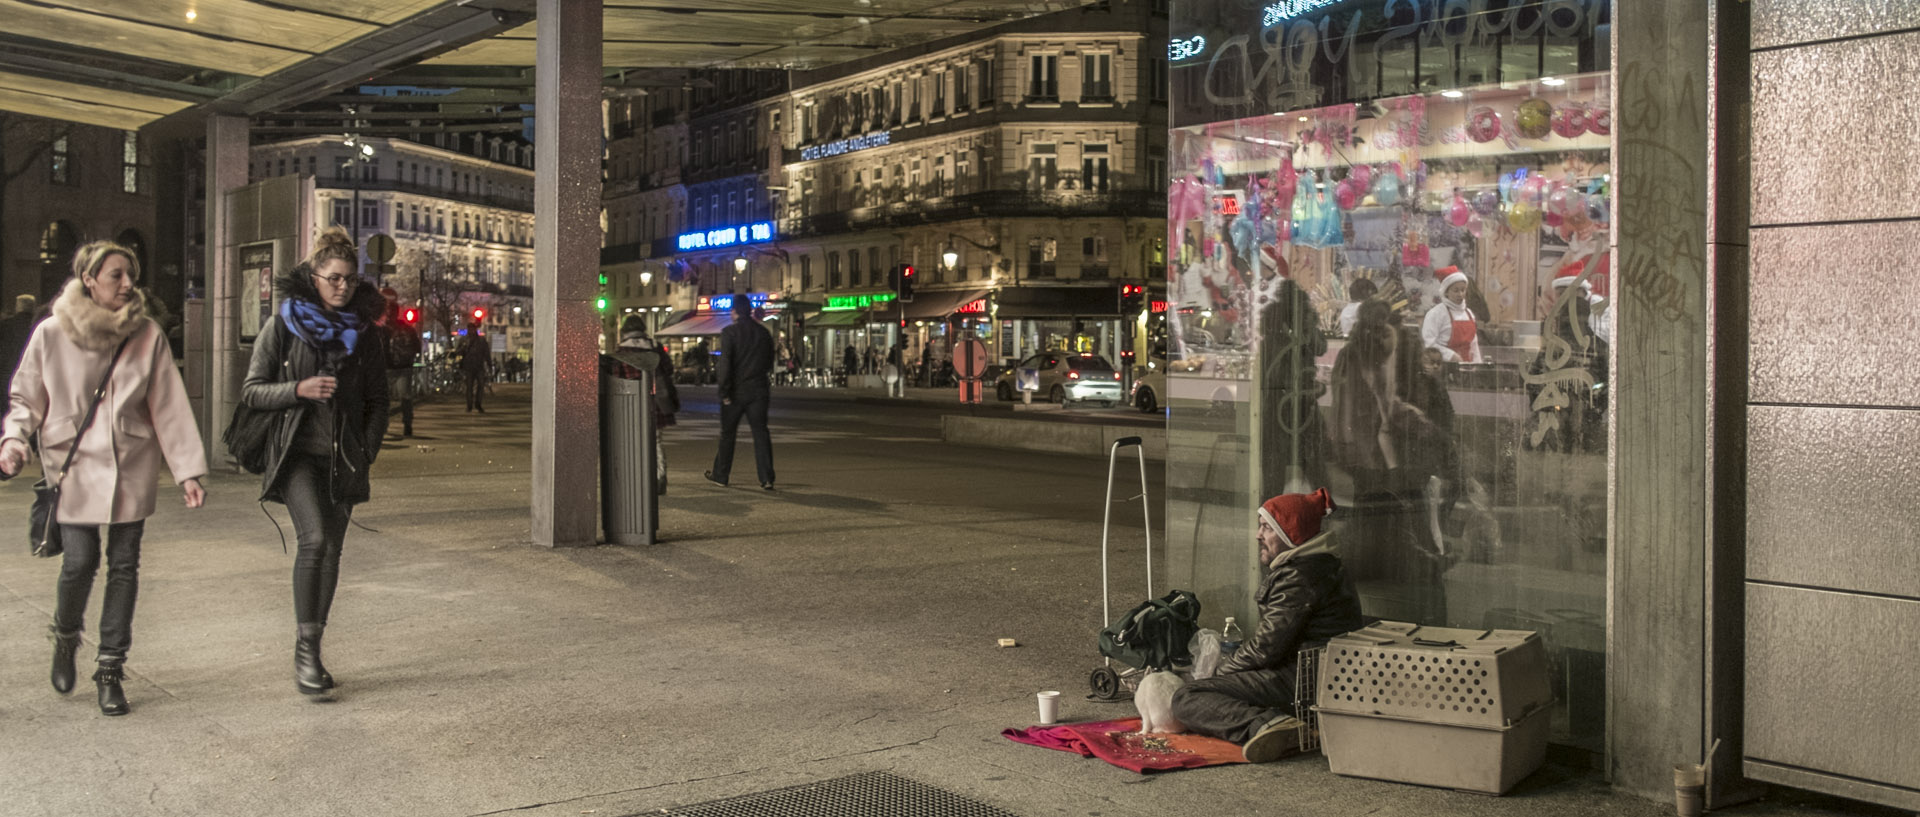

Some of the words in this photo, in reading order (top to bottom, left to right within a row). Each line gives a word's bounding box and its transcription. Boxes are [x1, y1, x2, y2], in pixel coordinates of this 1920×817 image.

[801, 145, 820, 160] HOTEL
[821, 139, 849, 157] FLANDRE
[849, 130, 890, 151] ANGLETERRE
[678, 232, 707, 250] HOTEL
